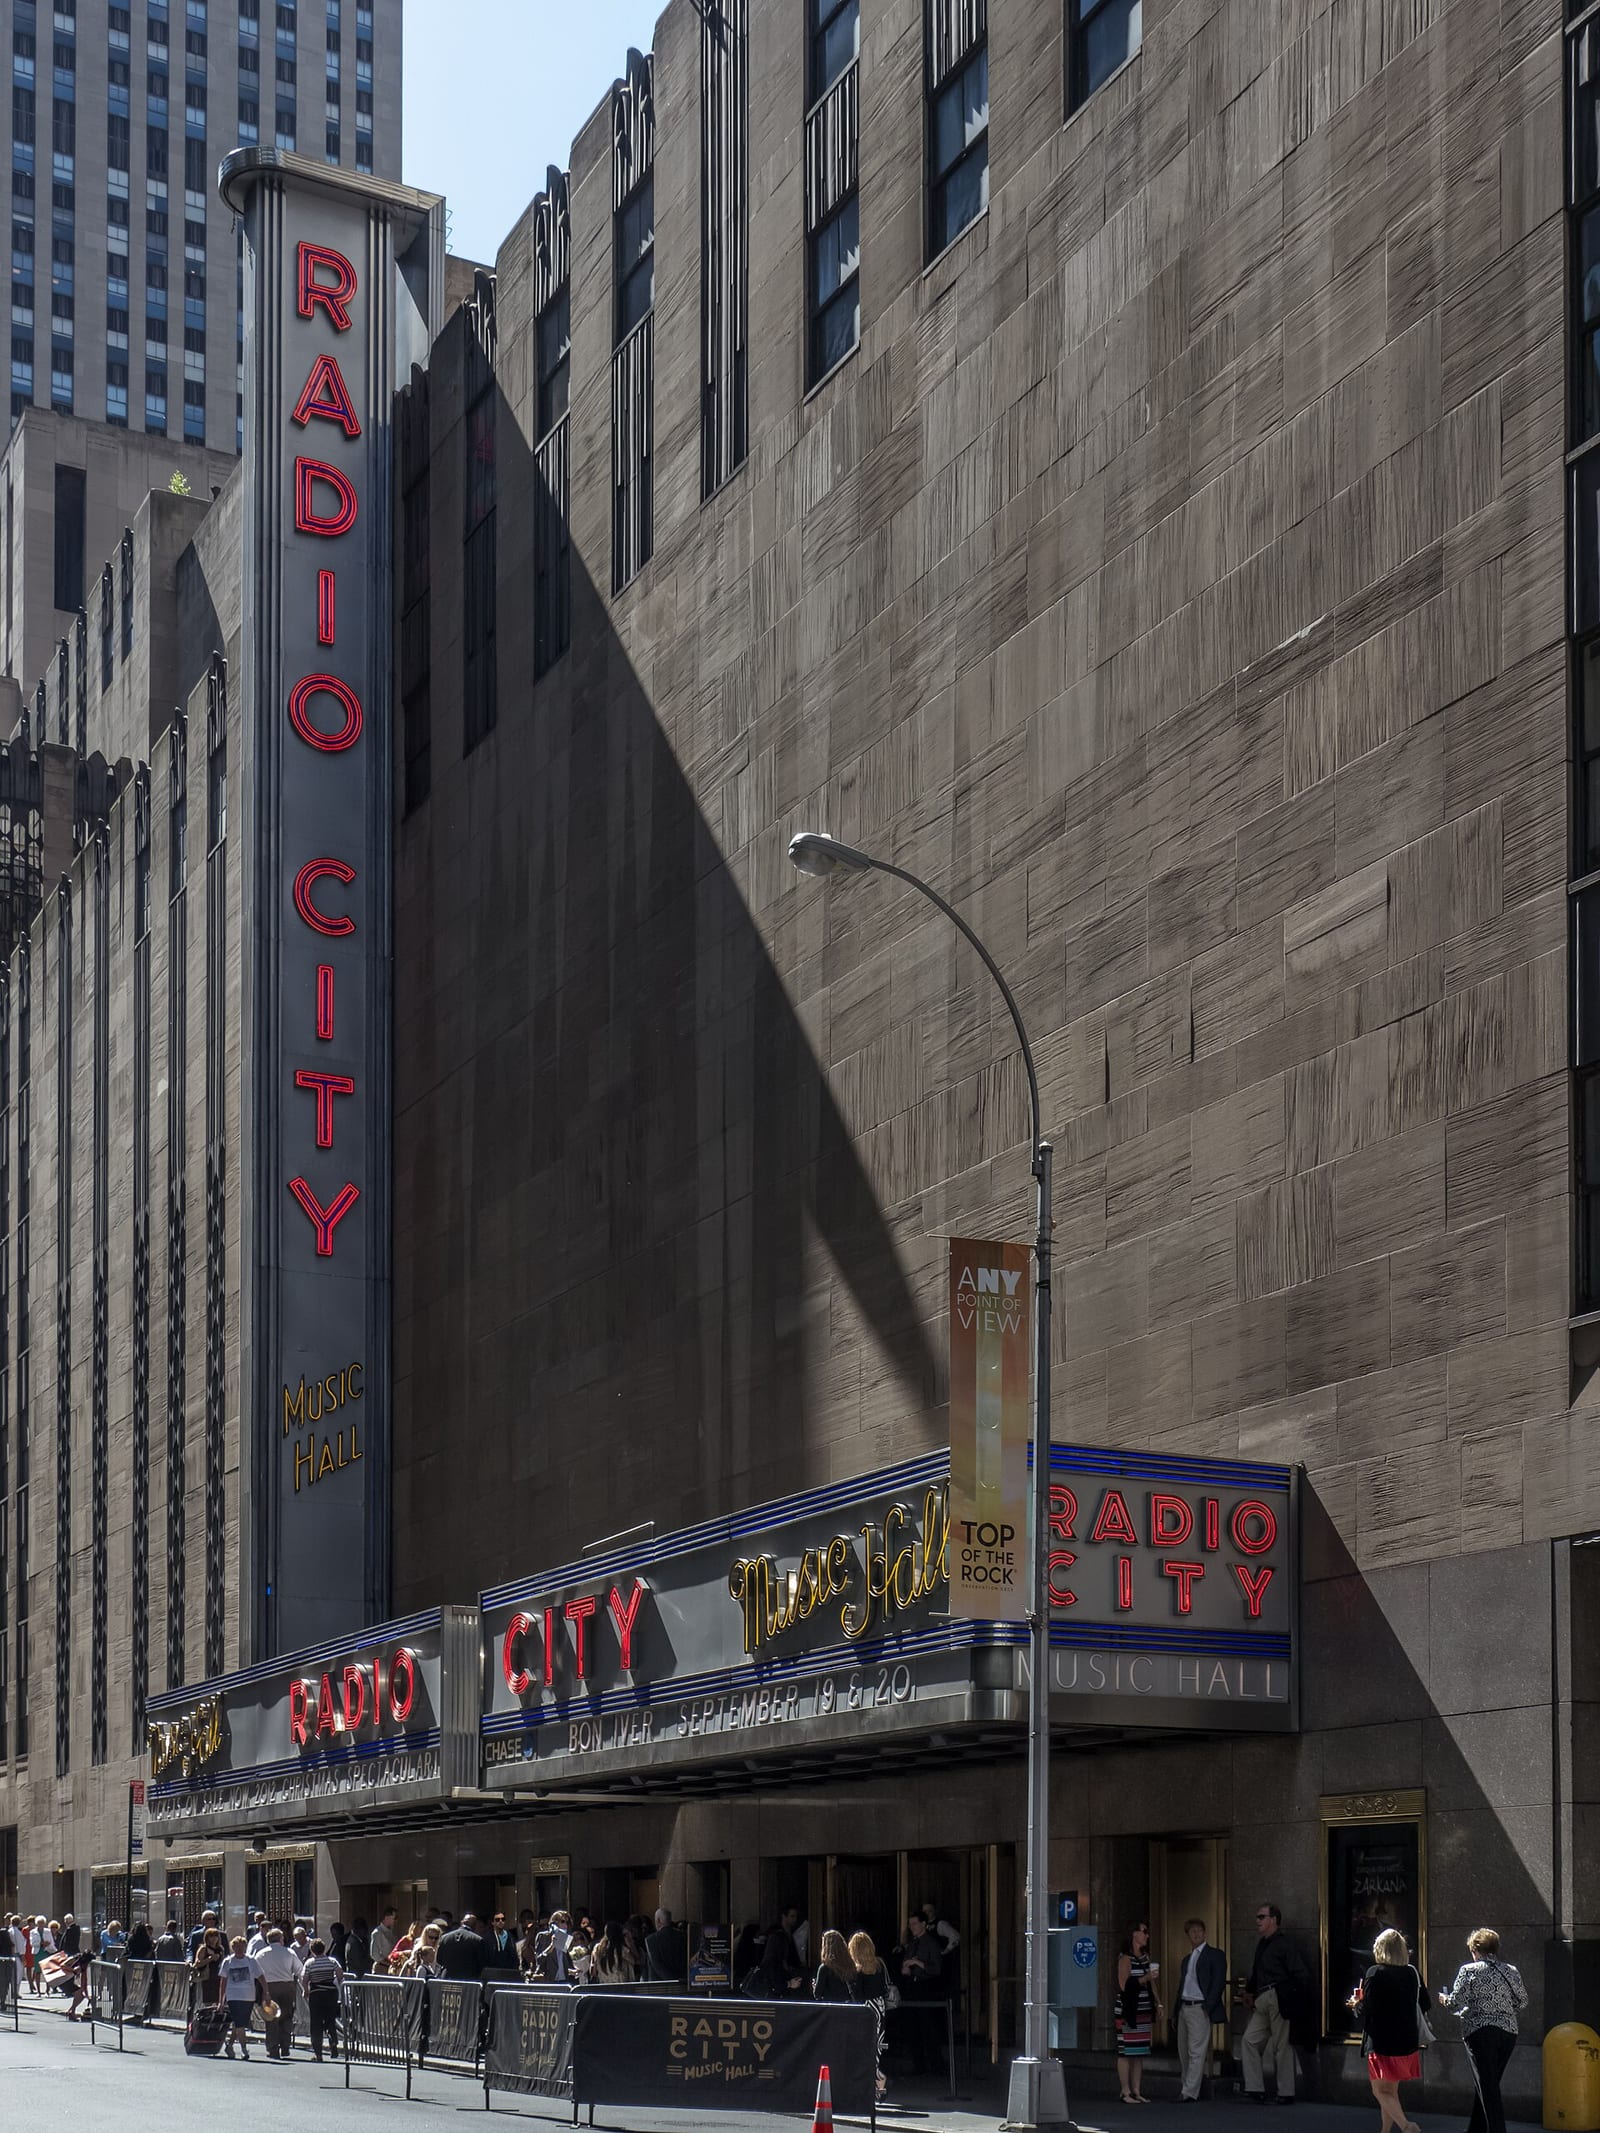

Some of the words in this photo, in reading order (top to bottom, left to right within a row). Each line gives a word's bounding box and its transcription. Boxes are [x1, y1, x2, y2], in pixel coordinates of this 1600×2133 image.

[287, 240, 363, 752] RADIO
[287, 857, 360, 1257] CITY
[957, 1266, 1022, 1296] ANY
[957, 1293, 1000, 1309] POINT
[1002, 1297, 1021, 1311] OF
[957, 1308, 1021, 1335] VIEW
[283, 1362, 364, 1437] MUSIC
[295, 1424, 364, 1494] HALL
[960, 1520, 1015, 1548] TOP
[1048, 1483, 1278, 1556] RADIO
[961, 1548, 982, 1563] OF
[985, 1550, 1015, 1566] THE
[1048, 1549, 1275, 1619] CITY
[502, 1577, 650, 1696] CITY
[728, 1534, 850, 1656] Music
[1178, 1660, 1285, 1701] HALL
[289, 1647, 415, 1745] RADIO
[568, 1718, 603, 1754] BON
[612, 1710, 654, 1748] IVER
[678, 1685, 800, 1735] SEPTEMBER
[815, 1677, 836, 1713] 19
[876, 1664, 912, 1703] 20
[483, 1737, 524, 1762] CHASE
[281, 1768, 341, 1801] CHRISTMAS
[1063, 1900, 1075, 1919] P
[522, 2009, 559, 2029] RADIO
[671, 2017, 773, 2040] RADIO
[520, 2030, 557, 2050] CITY
[669, 2040, 772, 2062] CITY
[684, 2062, 723, 2080] MUSIC
[725, 2064, 755, 2081] HALL
